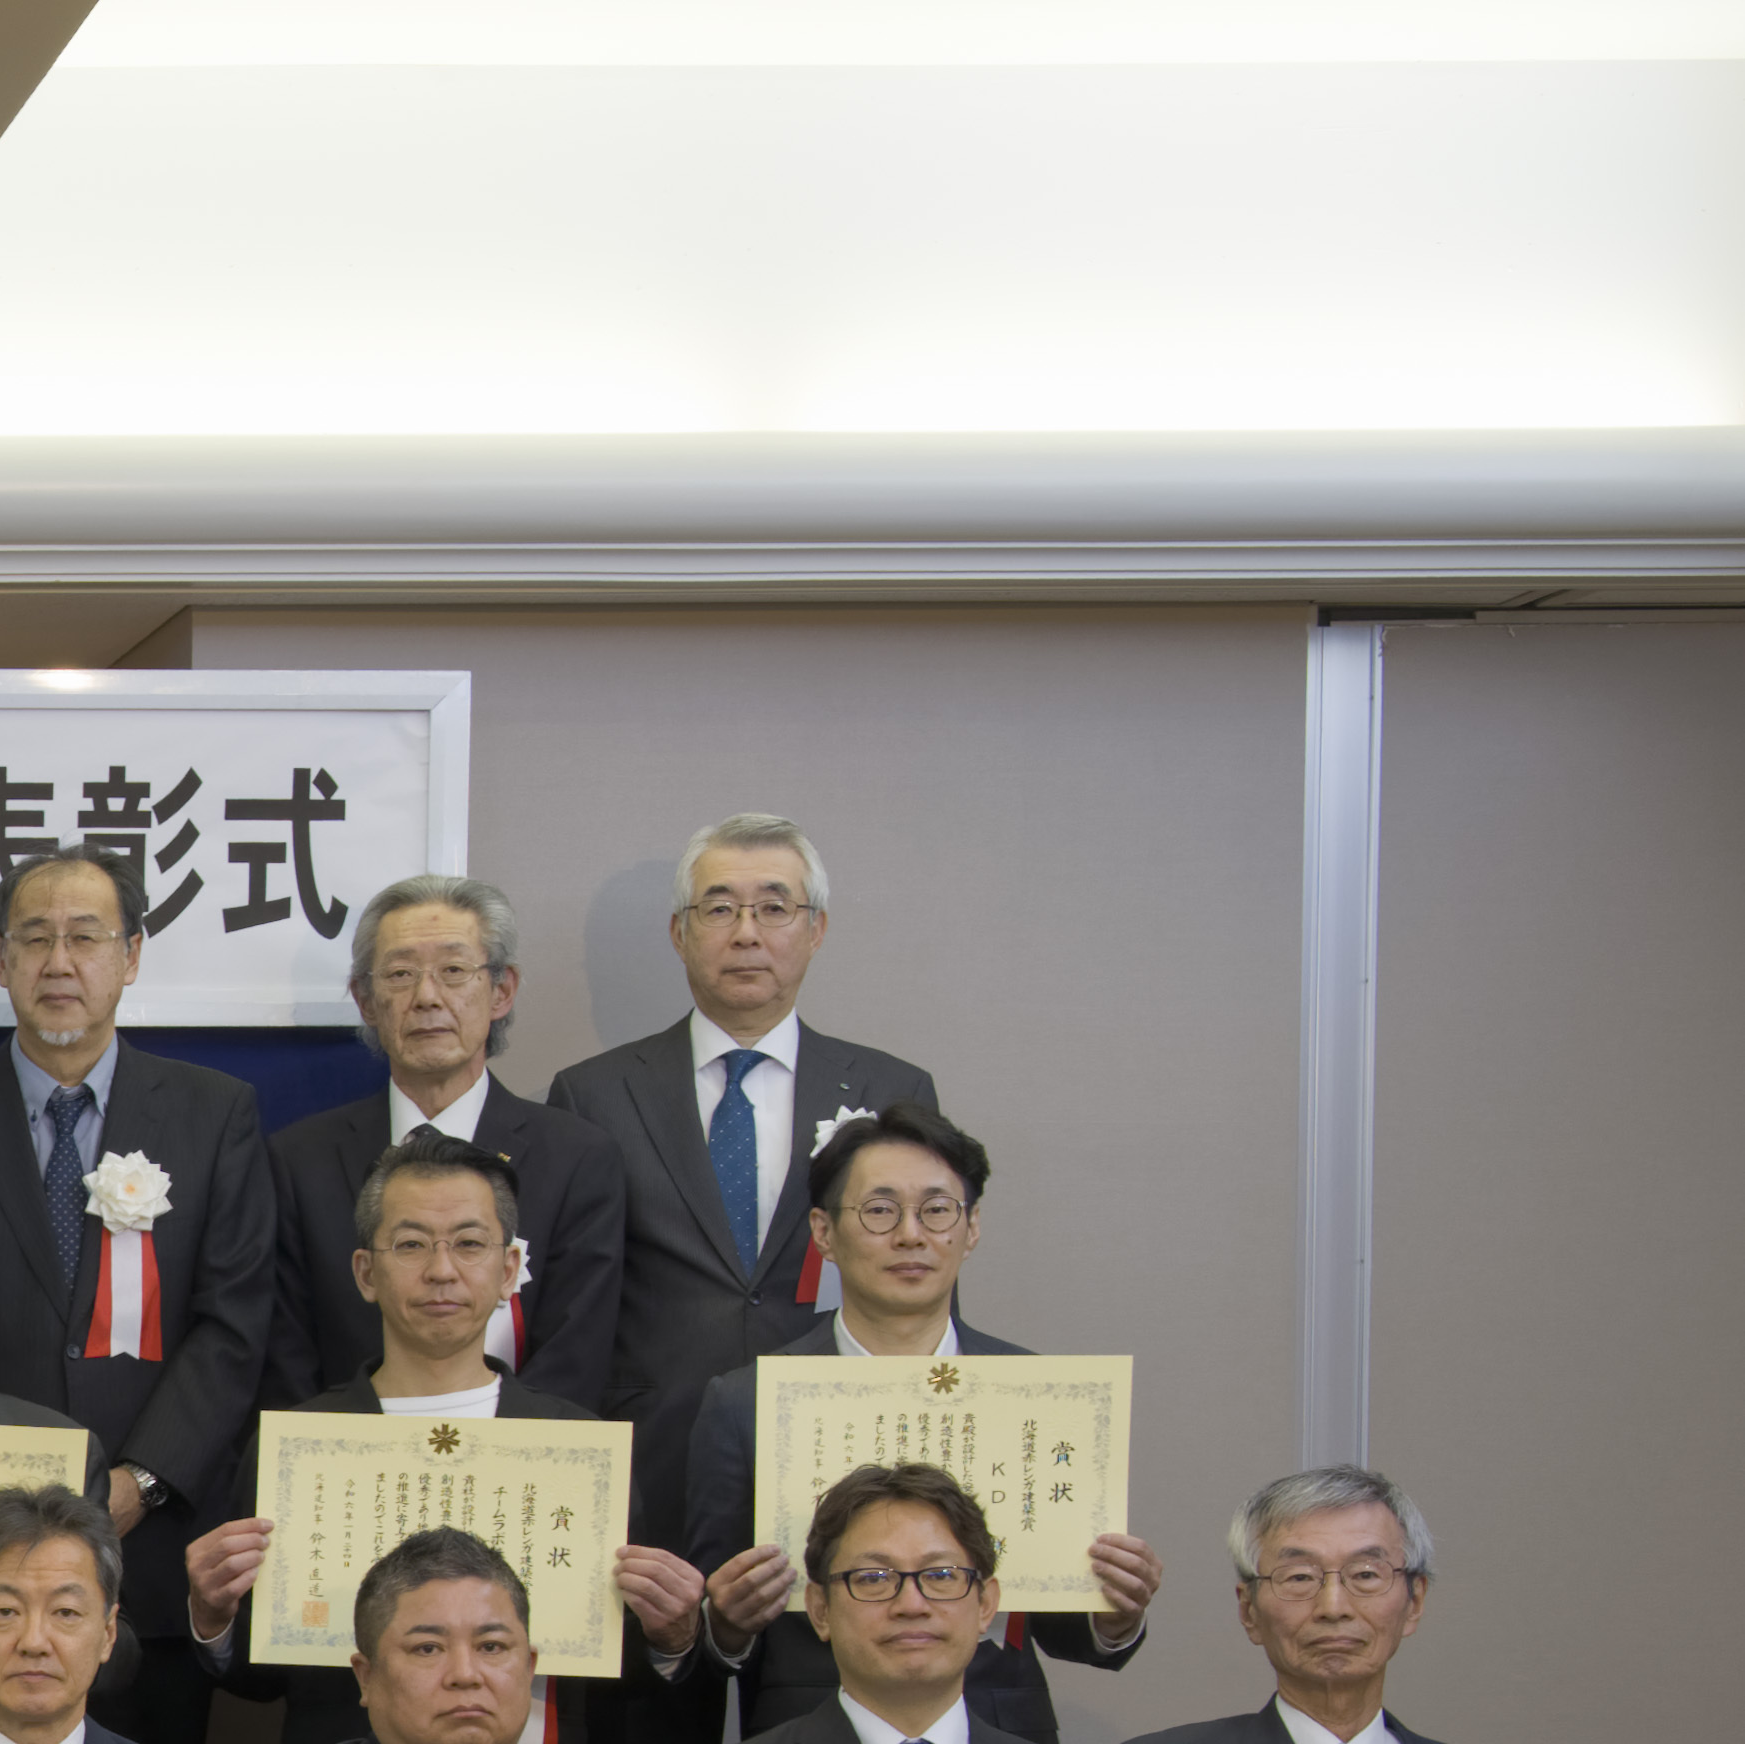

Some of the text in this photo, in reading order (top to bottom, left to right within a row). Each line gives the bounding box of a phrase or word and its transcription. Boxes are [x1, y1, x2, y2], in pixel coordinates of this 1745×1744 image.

[1021, 1419, 1037, 1532] 北海道赤レンガ建築賞
[1049, 1441, 1076, 1503] 賞状
[547, 1505, 574, 1568] 賞状
